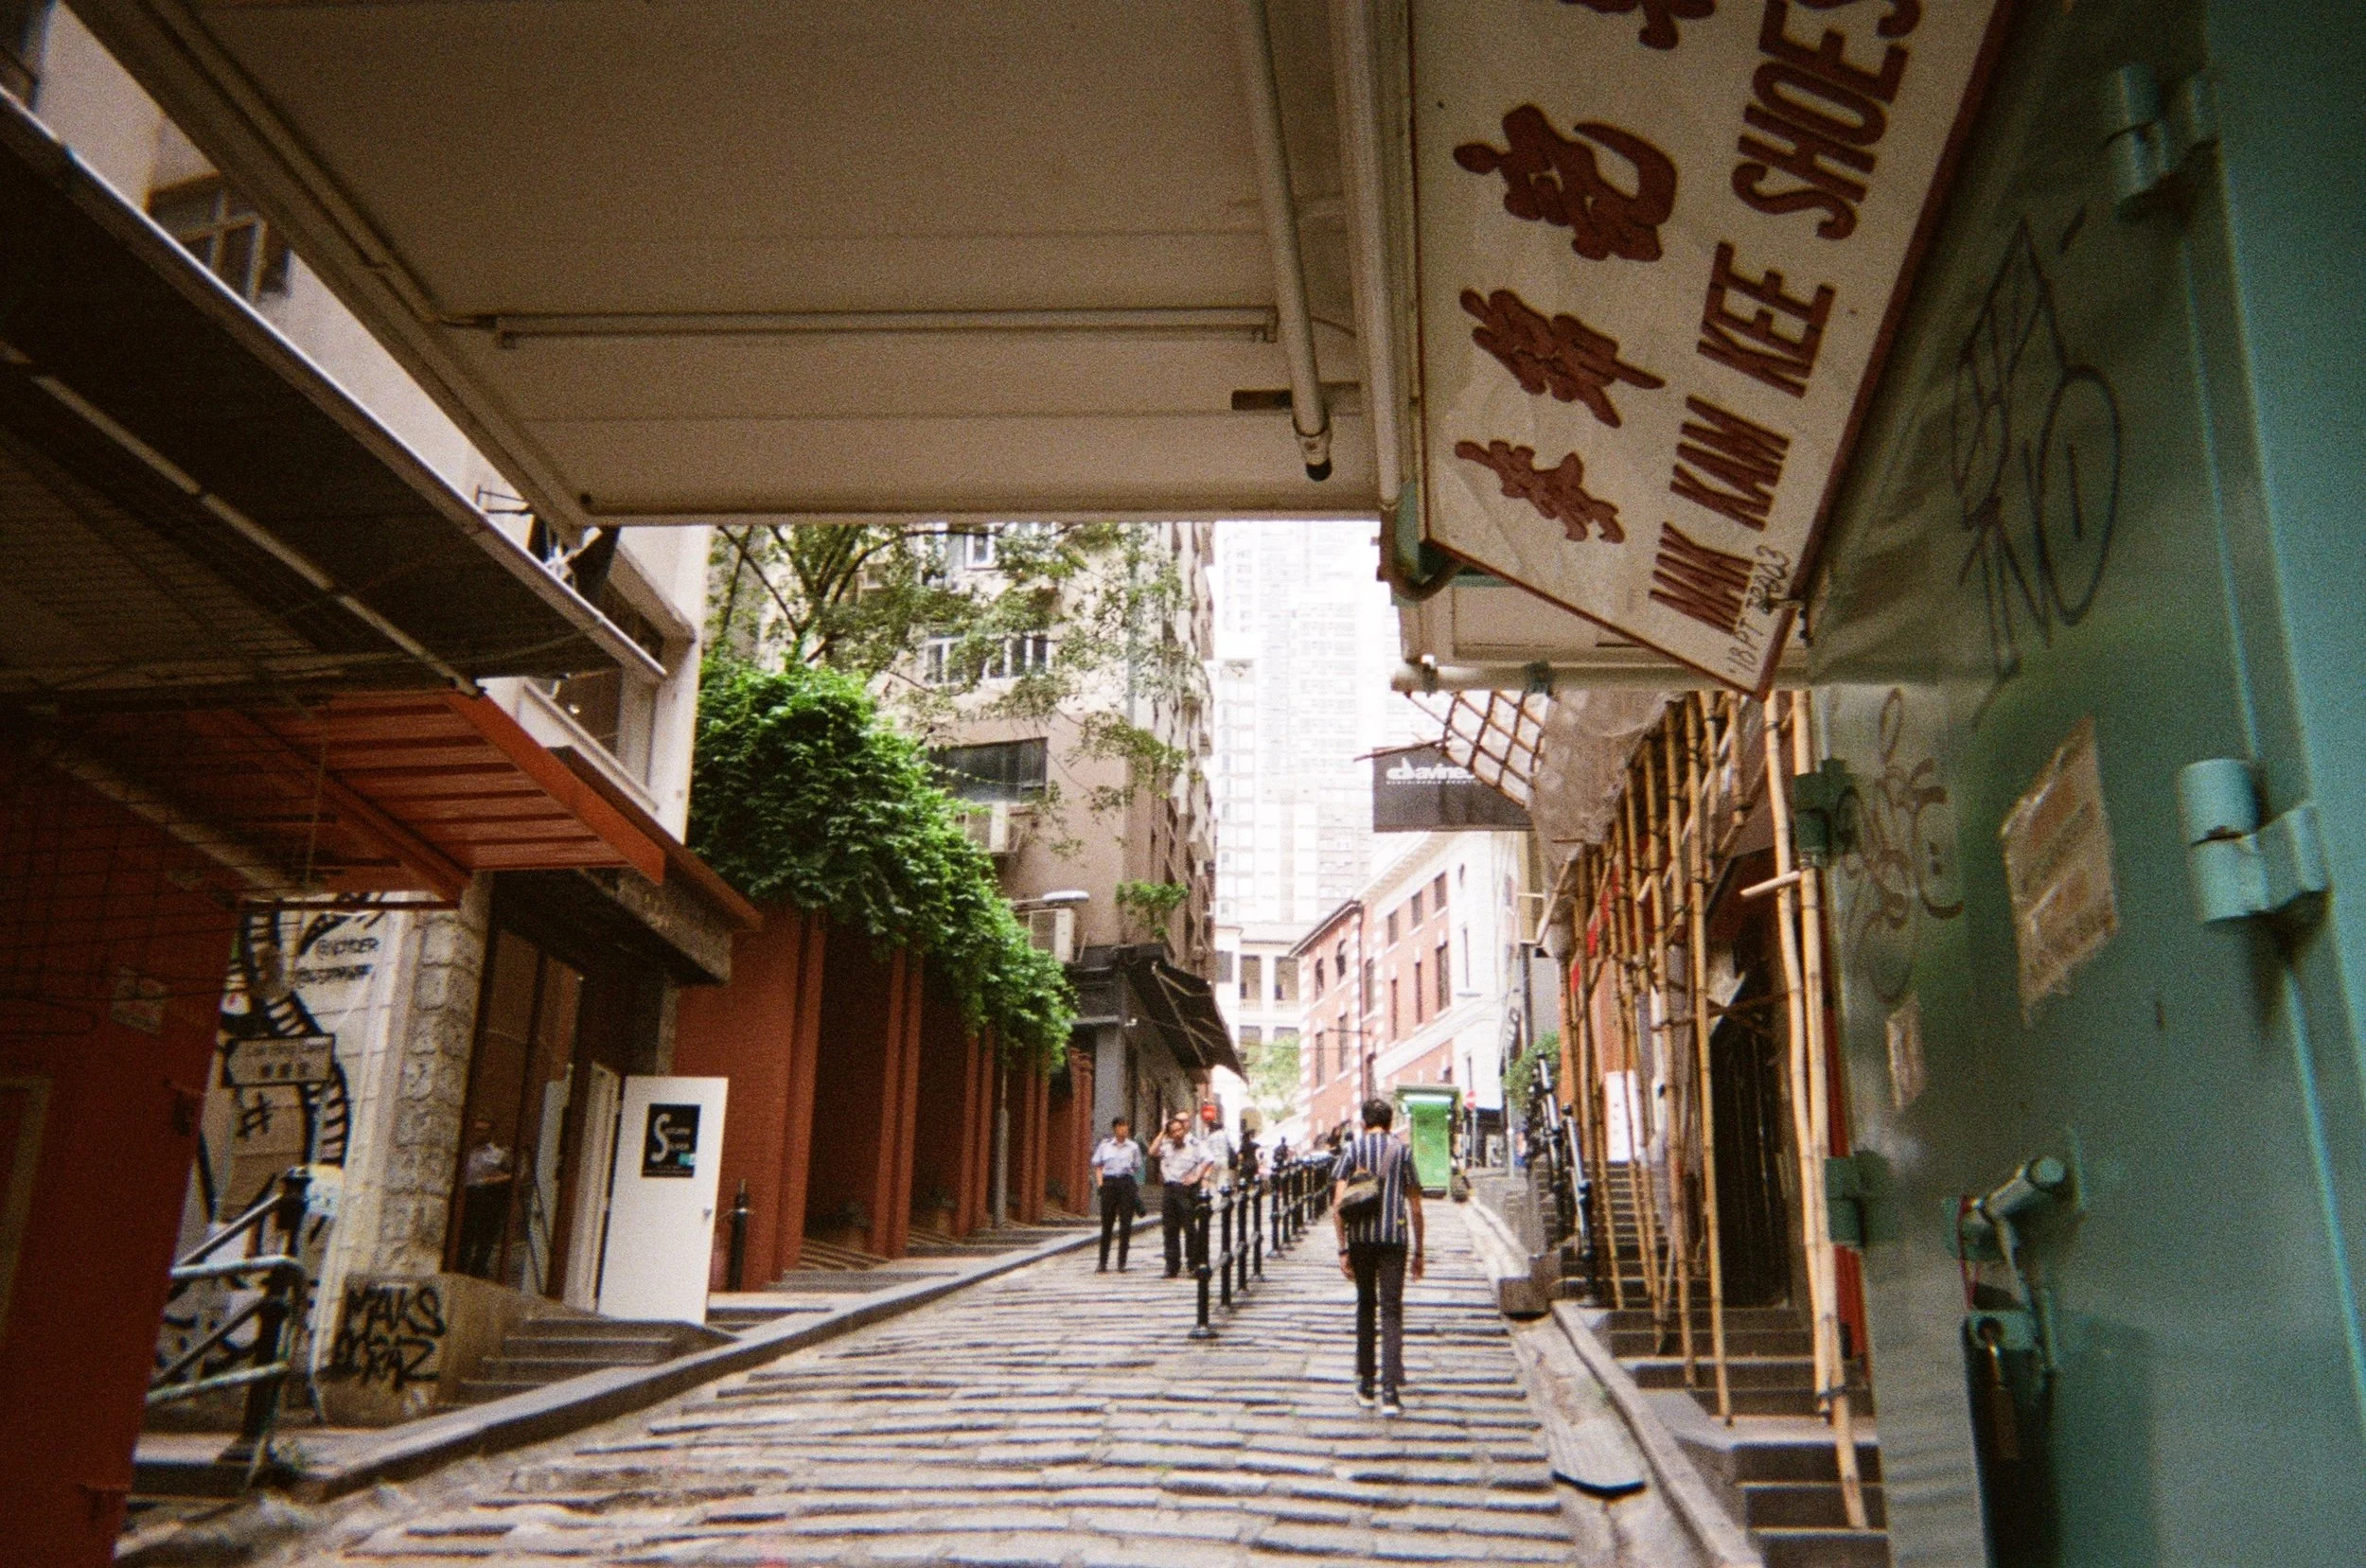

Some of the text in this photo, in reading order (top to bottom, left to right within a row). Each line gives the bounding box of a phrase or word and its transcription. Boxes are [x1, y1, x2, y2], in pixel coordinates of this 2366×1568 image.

[1453, 0, 1715, 544] 麥錦記
[1697, 240, 1836, 398] KEE
[1669, 396, 1790, 531] KAM
[1650, 521, 1754, 635] MAK
